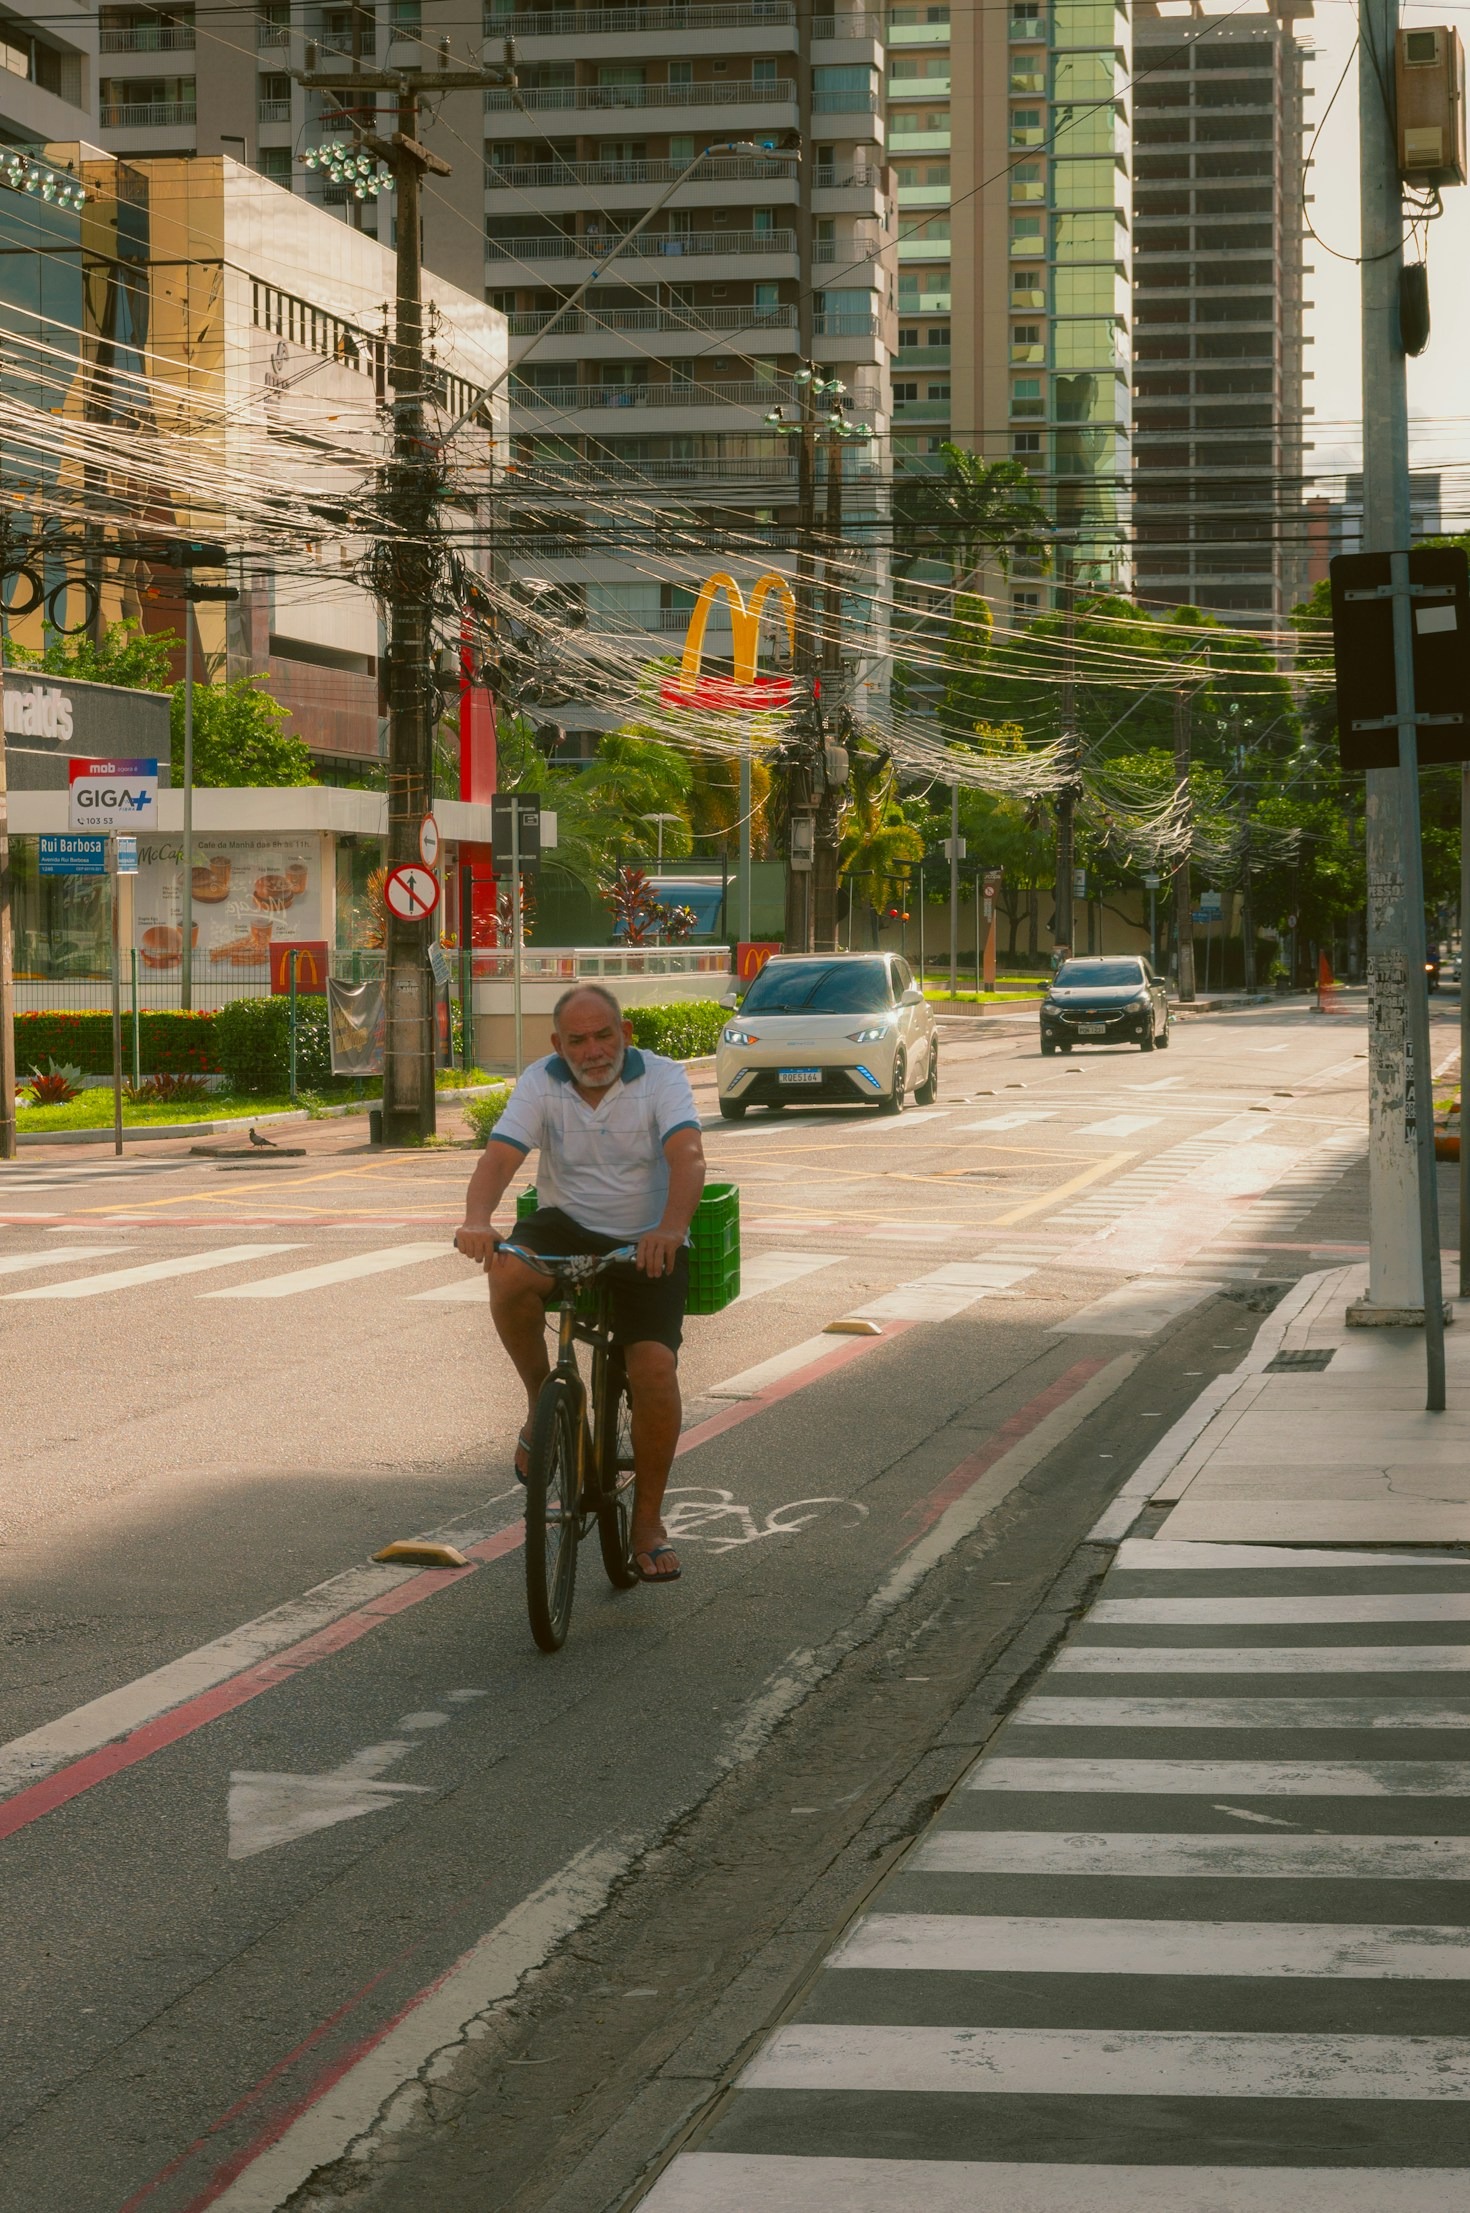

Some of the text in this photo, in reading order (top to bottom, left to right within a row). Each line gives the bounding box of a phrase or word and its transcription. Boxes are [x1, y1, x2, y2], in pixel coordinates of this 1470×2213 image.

[89, 762, 116, 774] mob
[86, 817, 114, 825] 103 53
[41, 838, 102, 853] Rui Barbosa
